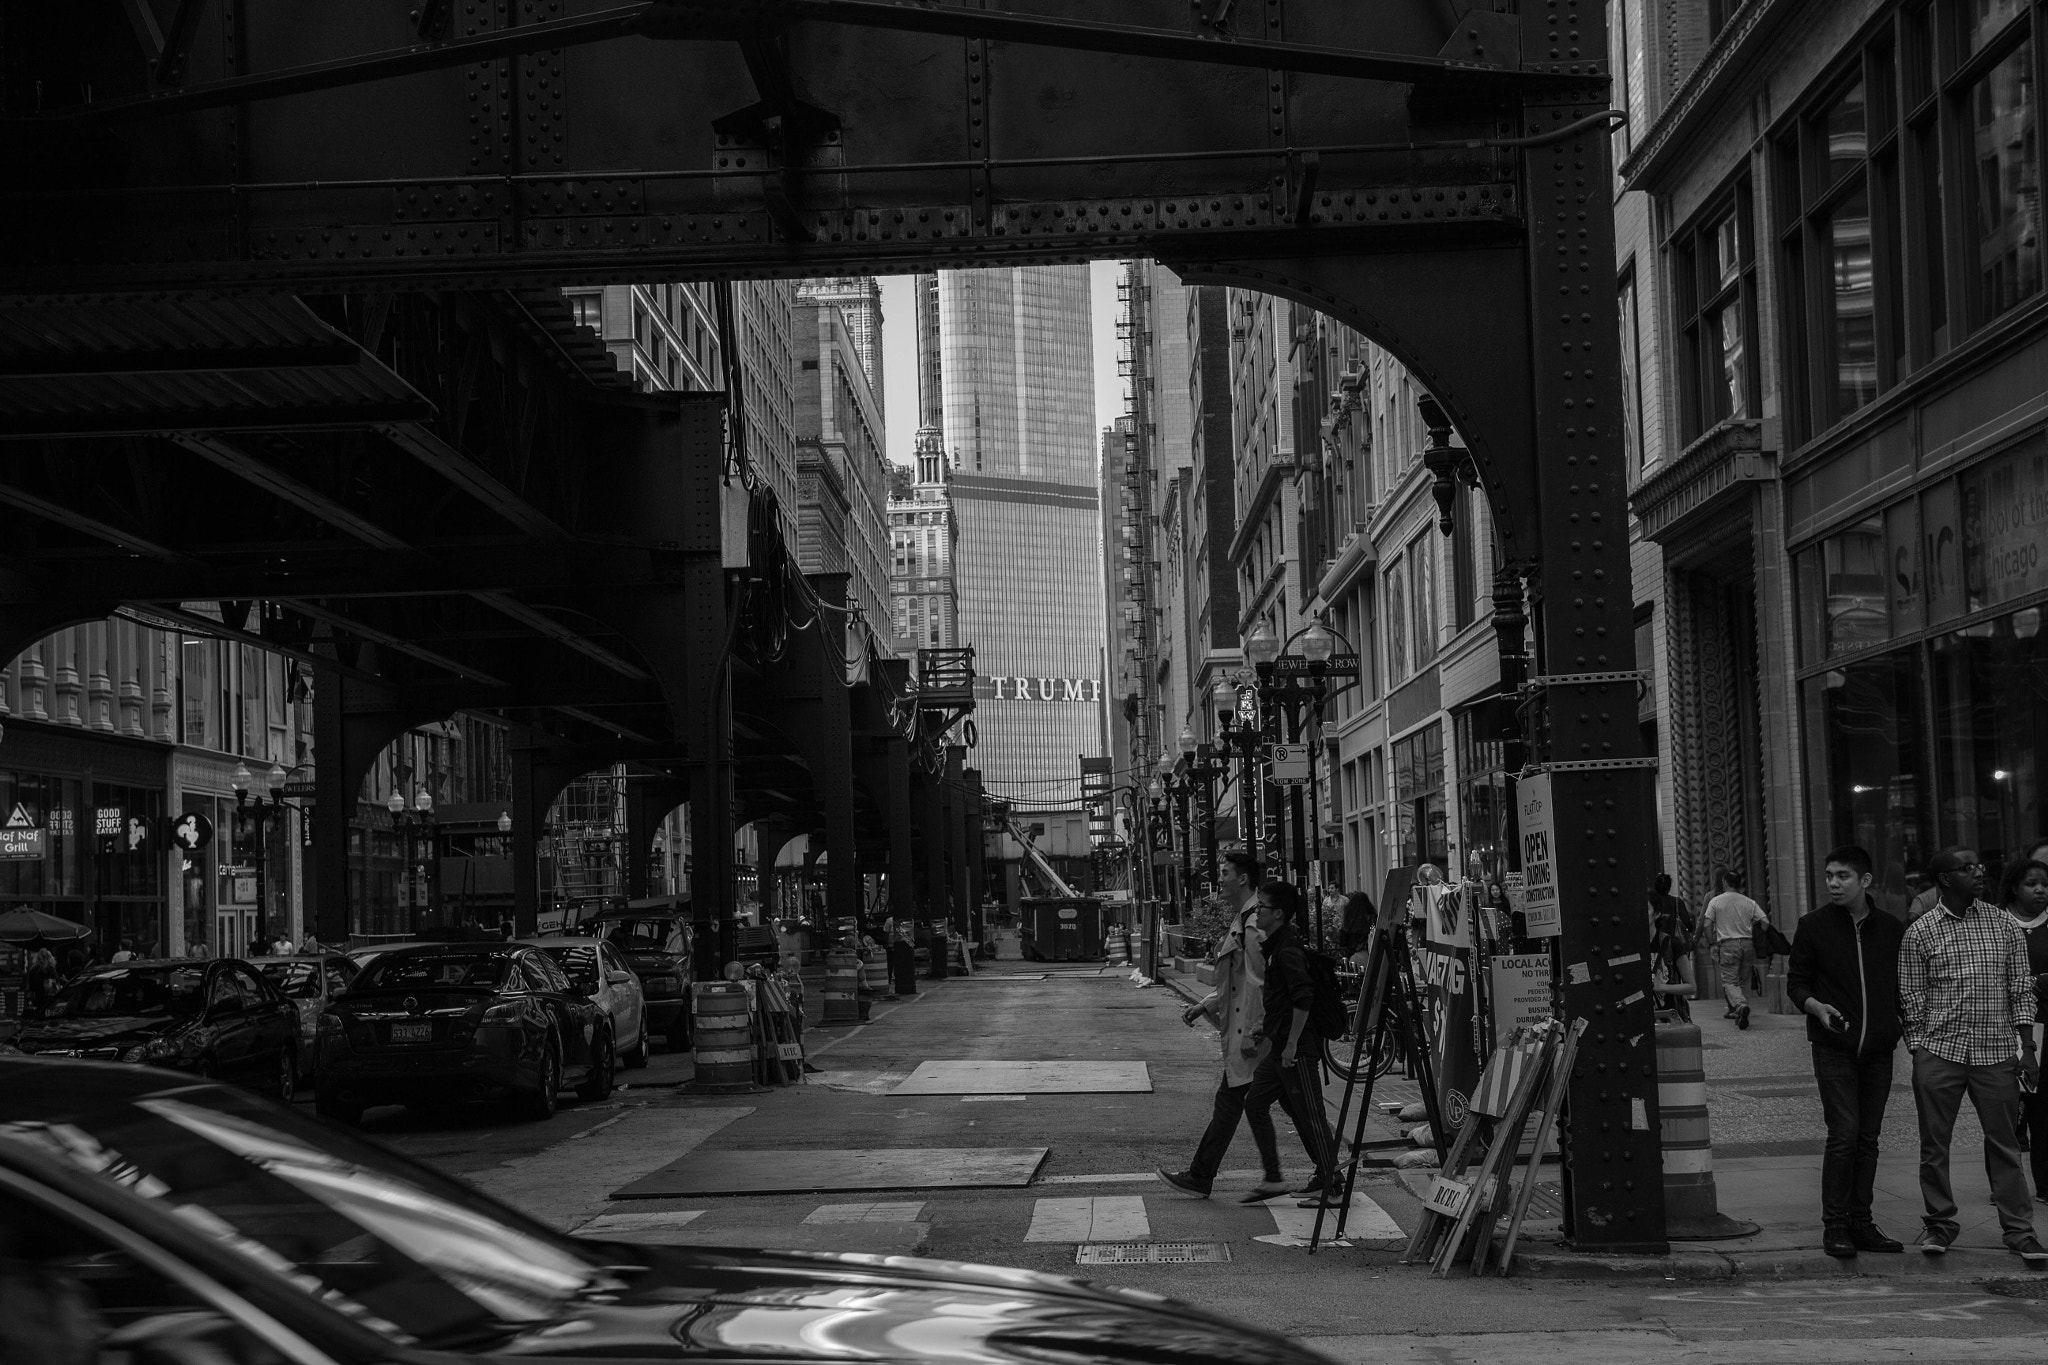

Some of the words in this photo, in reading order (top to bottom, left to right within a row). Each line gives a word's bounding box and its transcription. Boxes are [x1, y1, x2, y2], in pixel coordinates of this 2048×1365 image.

[1335, 658, 1359, 669] ROW
[1291, 777, 1307, 785] ZONE
[97, 808, 120, 818] GOOD
[96, 817, 122, 828] STUFF
[18, 831, 39, 842] Naf
[96, 827, 122, 835] EATERY
[5, 842, 28, 856] Grill
[1524, 830, 1549, 864] OPEN
[1200, 847, 1212, 904] ABASH
[1526, 861, 1551, 887] DURING
[1526, 885, 1555, 903] CONSTRUCTION
[1501, 958, 1533, 969] LOCAL
[1522, 970, 1533, 978] NO
[1535, 969, 1549, 977] THR
[1528, 1006, 1551, 1014] BUSINE
[1433, 1185, 1461, 1209] RCEC
